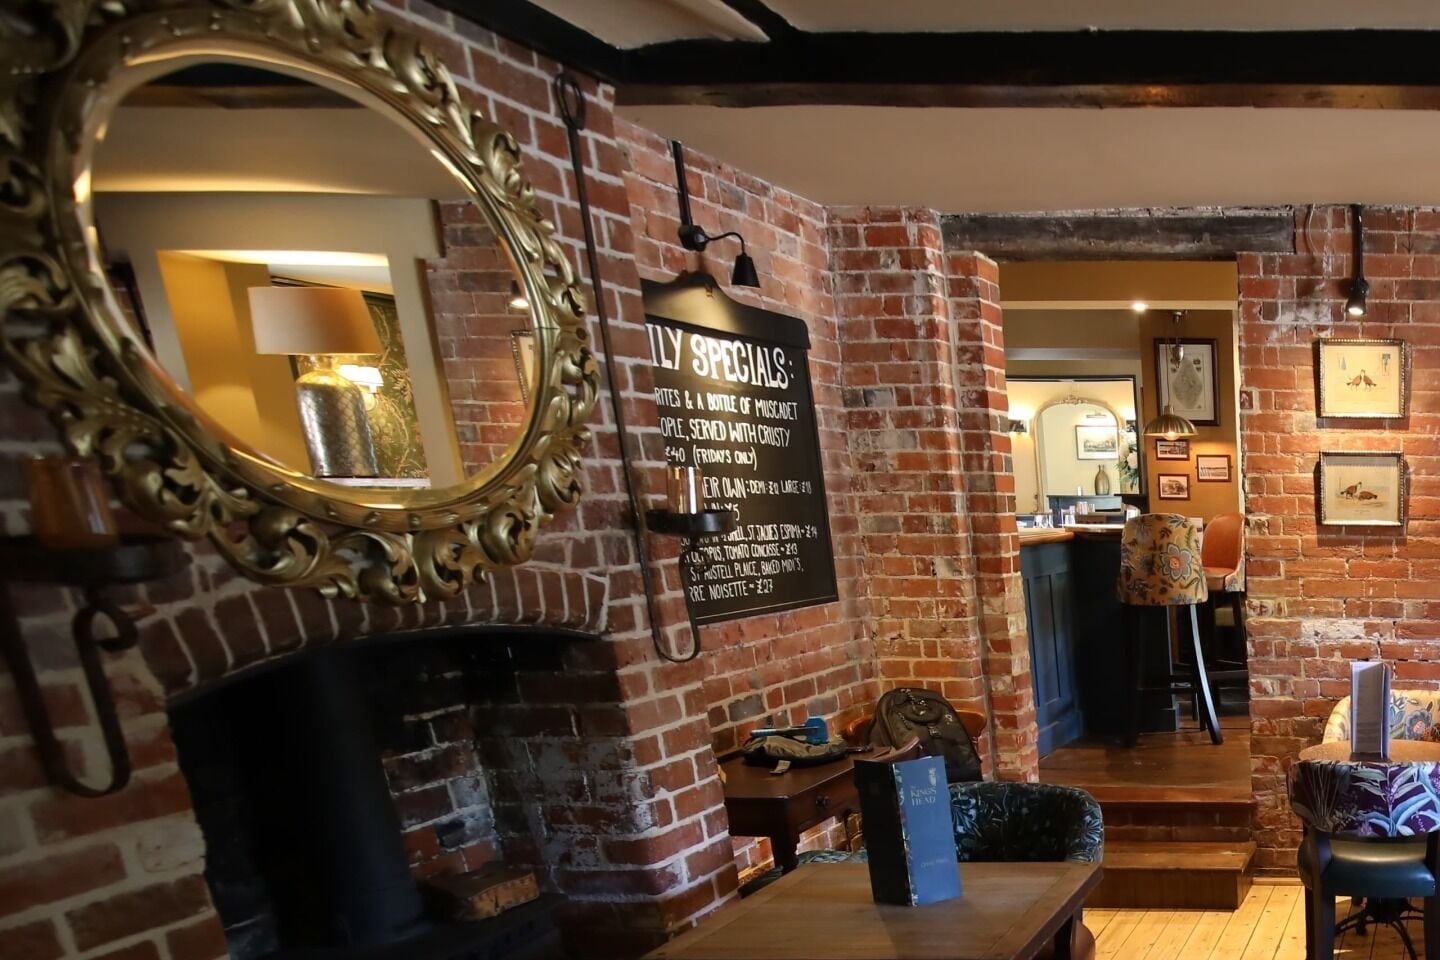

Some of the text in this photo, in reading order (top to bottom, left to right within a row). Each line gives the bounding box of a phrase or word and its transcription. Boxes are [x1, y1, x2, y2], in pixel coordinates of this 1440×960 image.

[645, 323, 795, 390] ILY SPECIALS:
[654, 387, 798, 420] RITES & A BOTTLE OF MUSCADET
[660, 417, 790, 448] OPLE, SERVED WITH CRUSTY
[693, 444, 731, 467] (FRIDAYS
[735, 446, 757, 471] ONLY)
[702, 476, 721, 499] EIR
[723, 543, 750, 560] TOMATO
[751, 543, 781, 558] CONCASSE
[760, 559, 781, 576] BAKED
[708, 580, 749, 601] NOISETTE
[755, 578, 773, 595] £27
[911, 797, 936, 807] HEAD
